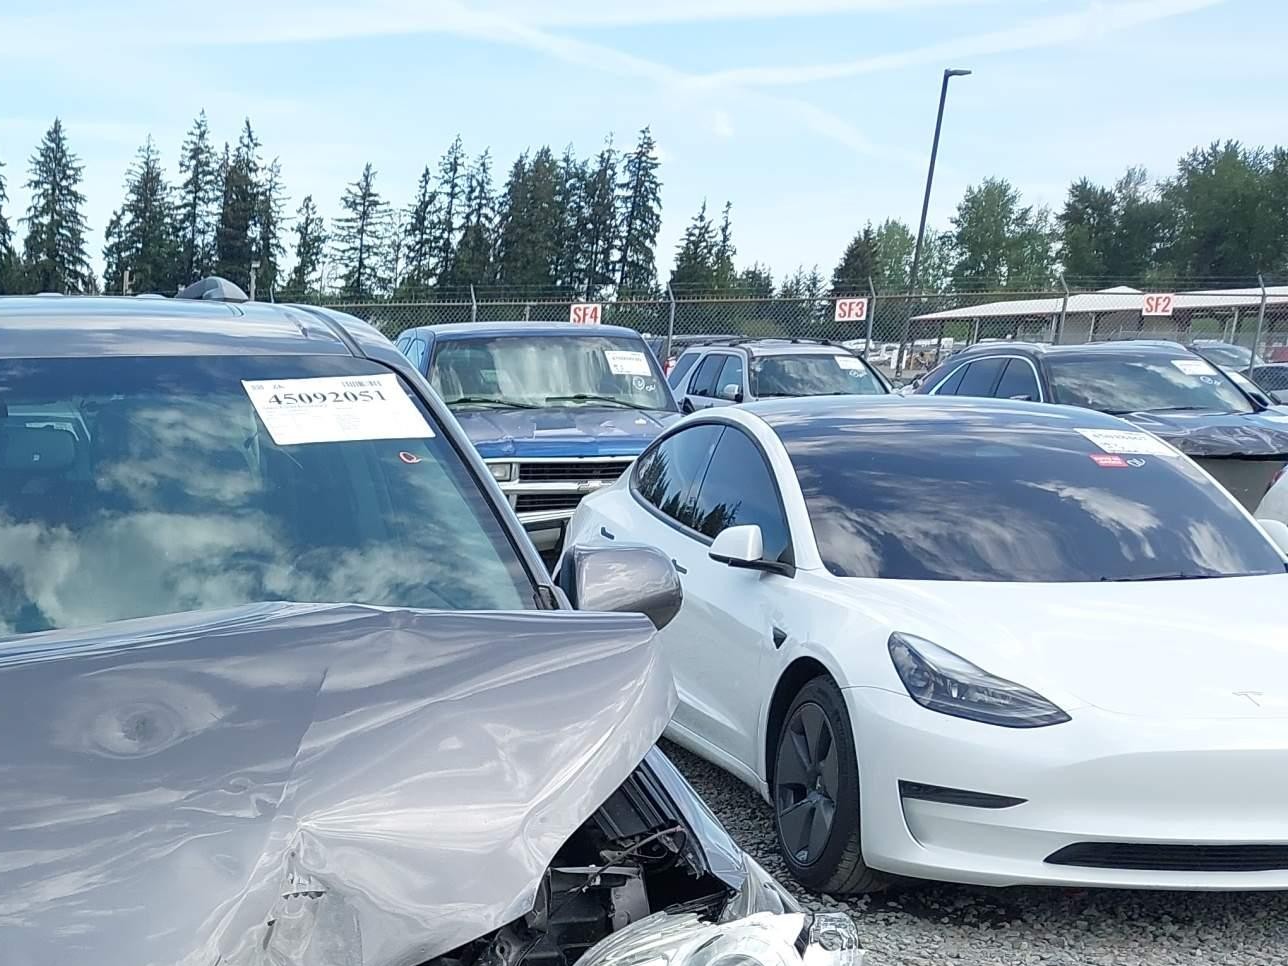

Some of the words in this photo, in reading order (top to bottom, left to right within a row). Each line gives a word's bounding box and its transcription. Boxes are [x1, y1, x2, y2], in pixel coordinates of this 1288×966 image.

[838, 301, 865, 318] SF3
[1145, 296, 1171, 313] SF2
[573, 306, 598, 324] SF4
[268, 389, 387, 405] 45092051
